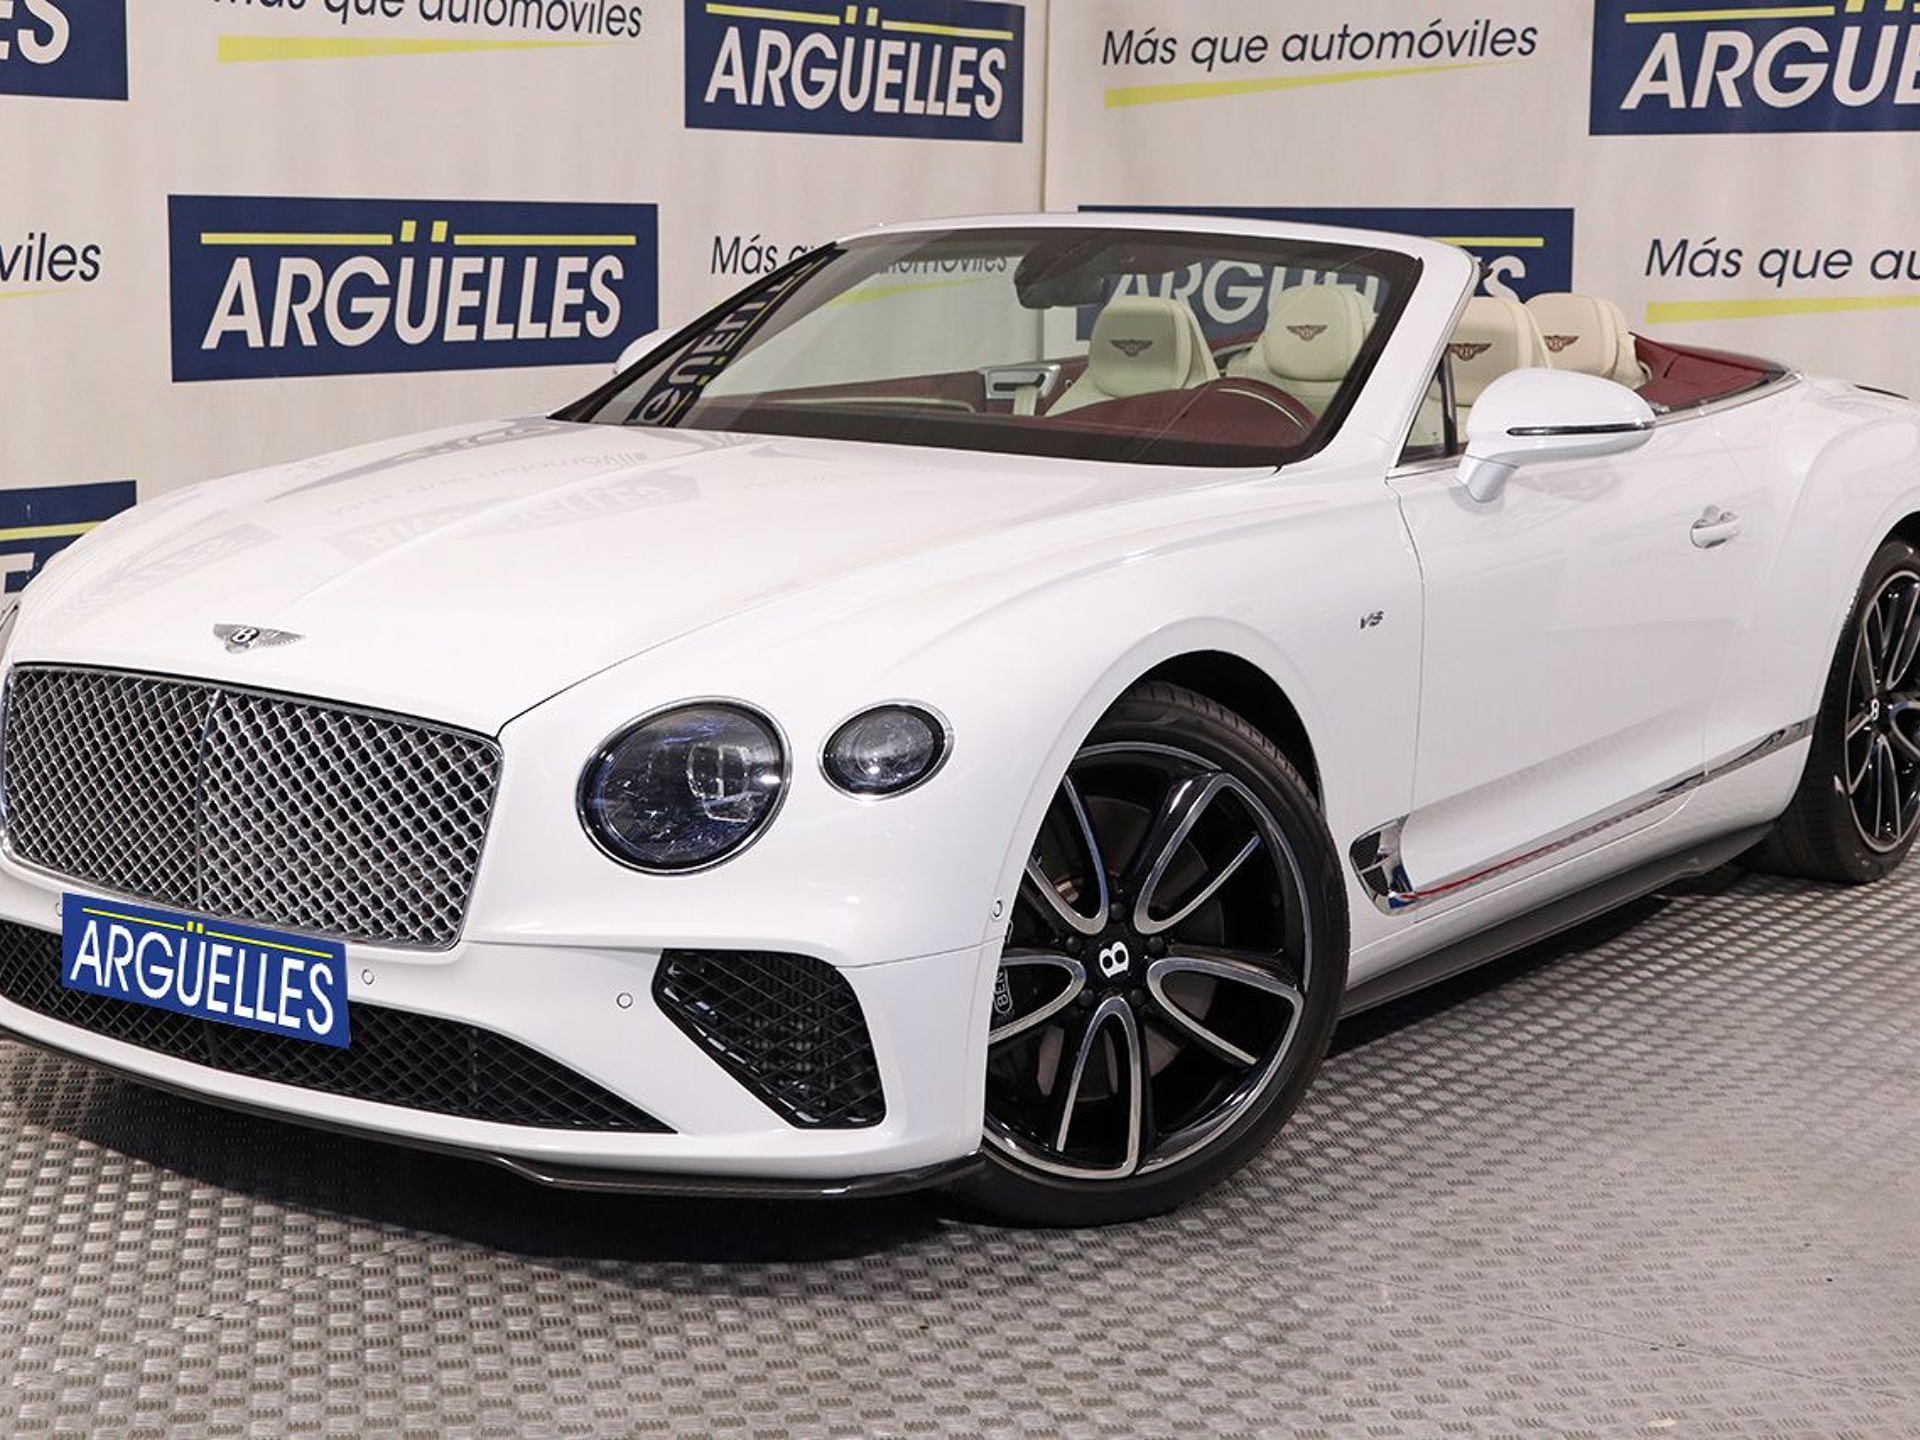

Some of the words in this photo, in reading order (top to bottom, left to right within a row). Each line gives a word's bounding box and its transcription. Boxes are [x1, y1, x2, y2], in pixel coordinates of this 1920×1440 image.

[0, 0, 70, 64] S
[1102, 27, 1177, 65] Más
[1191, 34, 1268, 72] que
[1282, 18, 1538, 62] automóviles
[704, 5, 1006, 119] ARGÜELLES
[711, 234, 778, 274] Más
[1645, 236, 1743, 278] Más
[1758, 249, 1853, 288] que
[201, 221, 624, 350] ARGÜELLES
